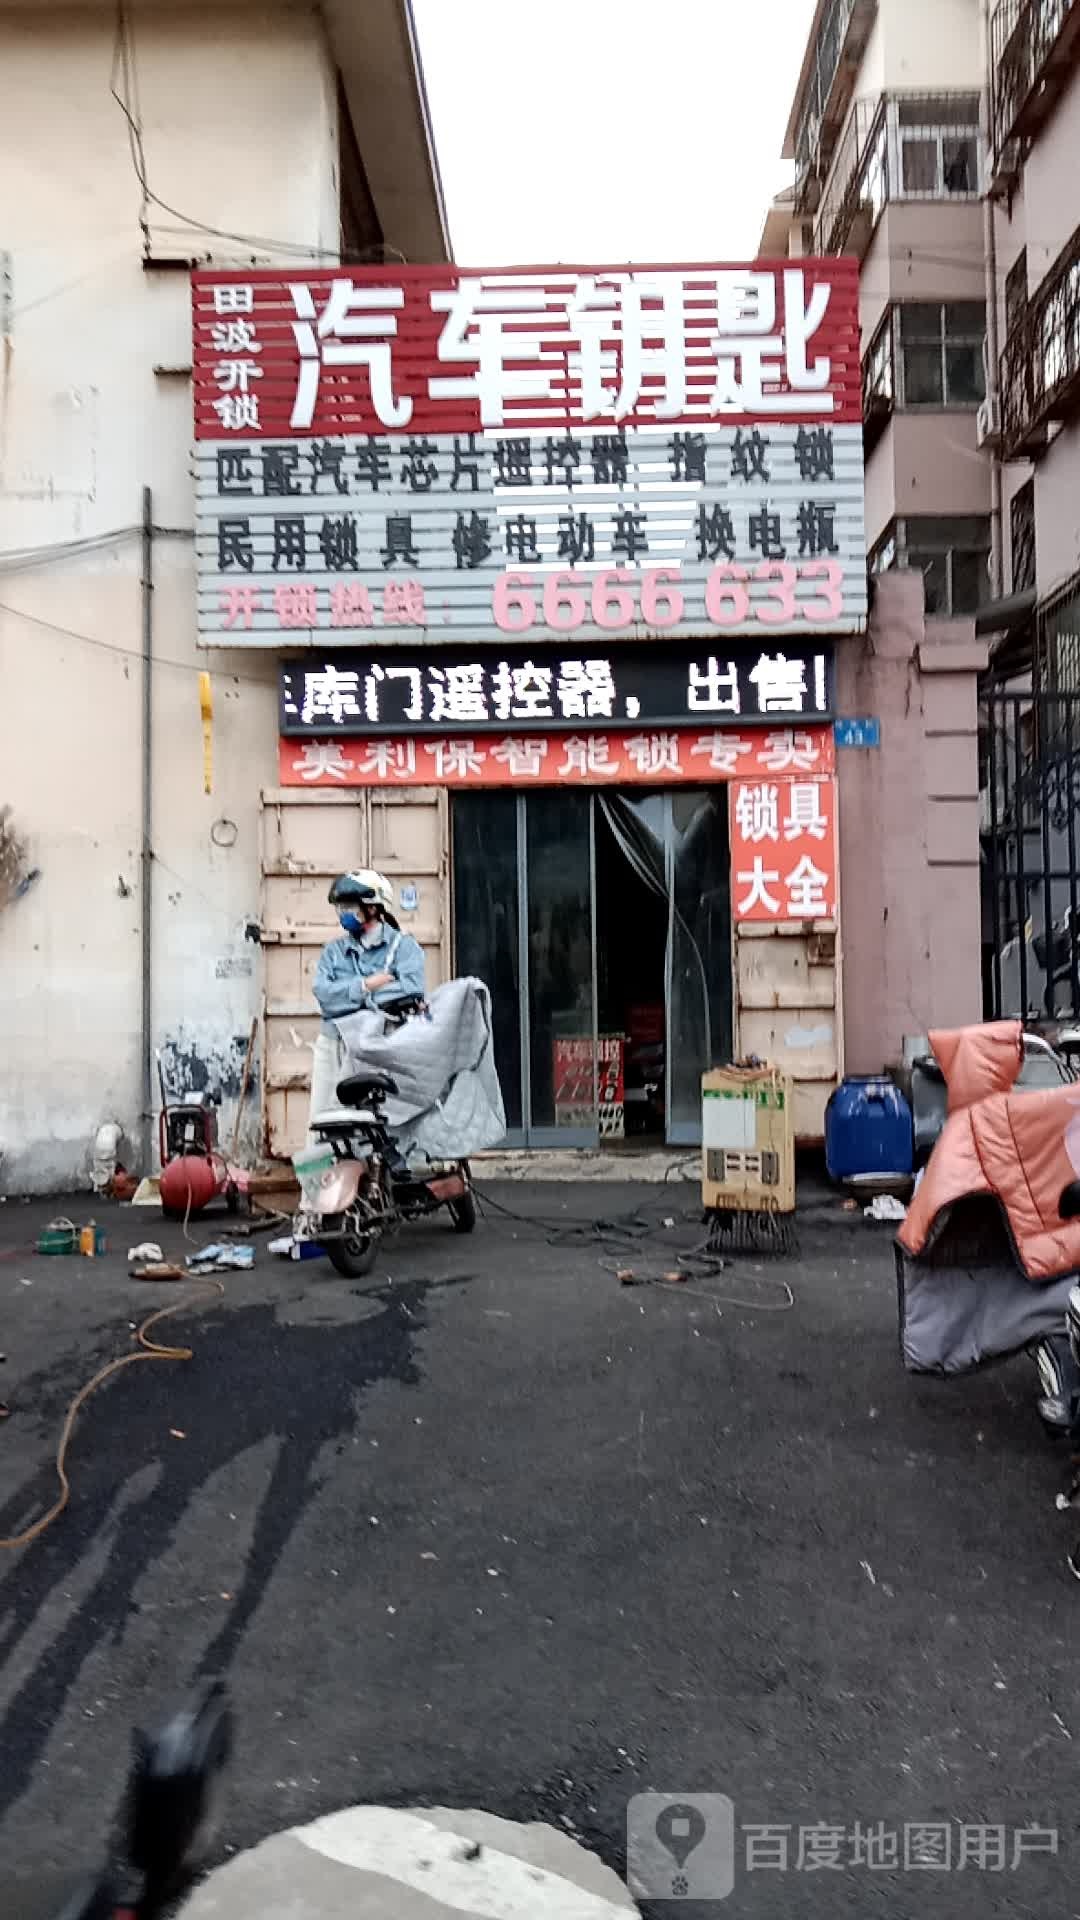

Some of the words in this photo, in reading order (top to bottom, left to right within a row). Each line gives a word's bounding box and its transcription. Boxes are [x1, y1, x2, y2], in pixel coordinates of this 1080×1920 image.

[211, 286, 264, 430] 田波开锁
[289, 269, 833, 427] 汽车钥匙
[217, 435, 629, 496] 匹配汽车芯片遥控器
[668, 426, 834, 483] 指纹锁
[736, 782, 828, 843] 锁具
[737, 854, 829, 917] 大全
